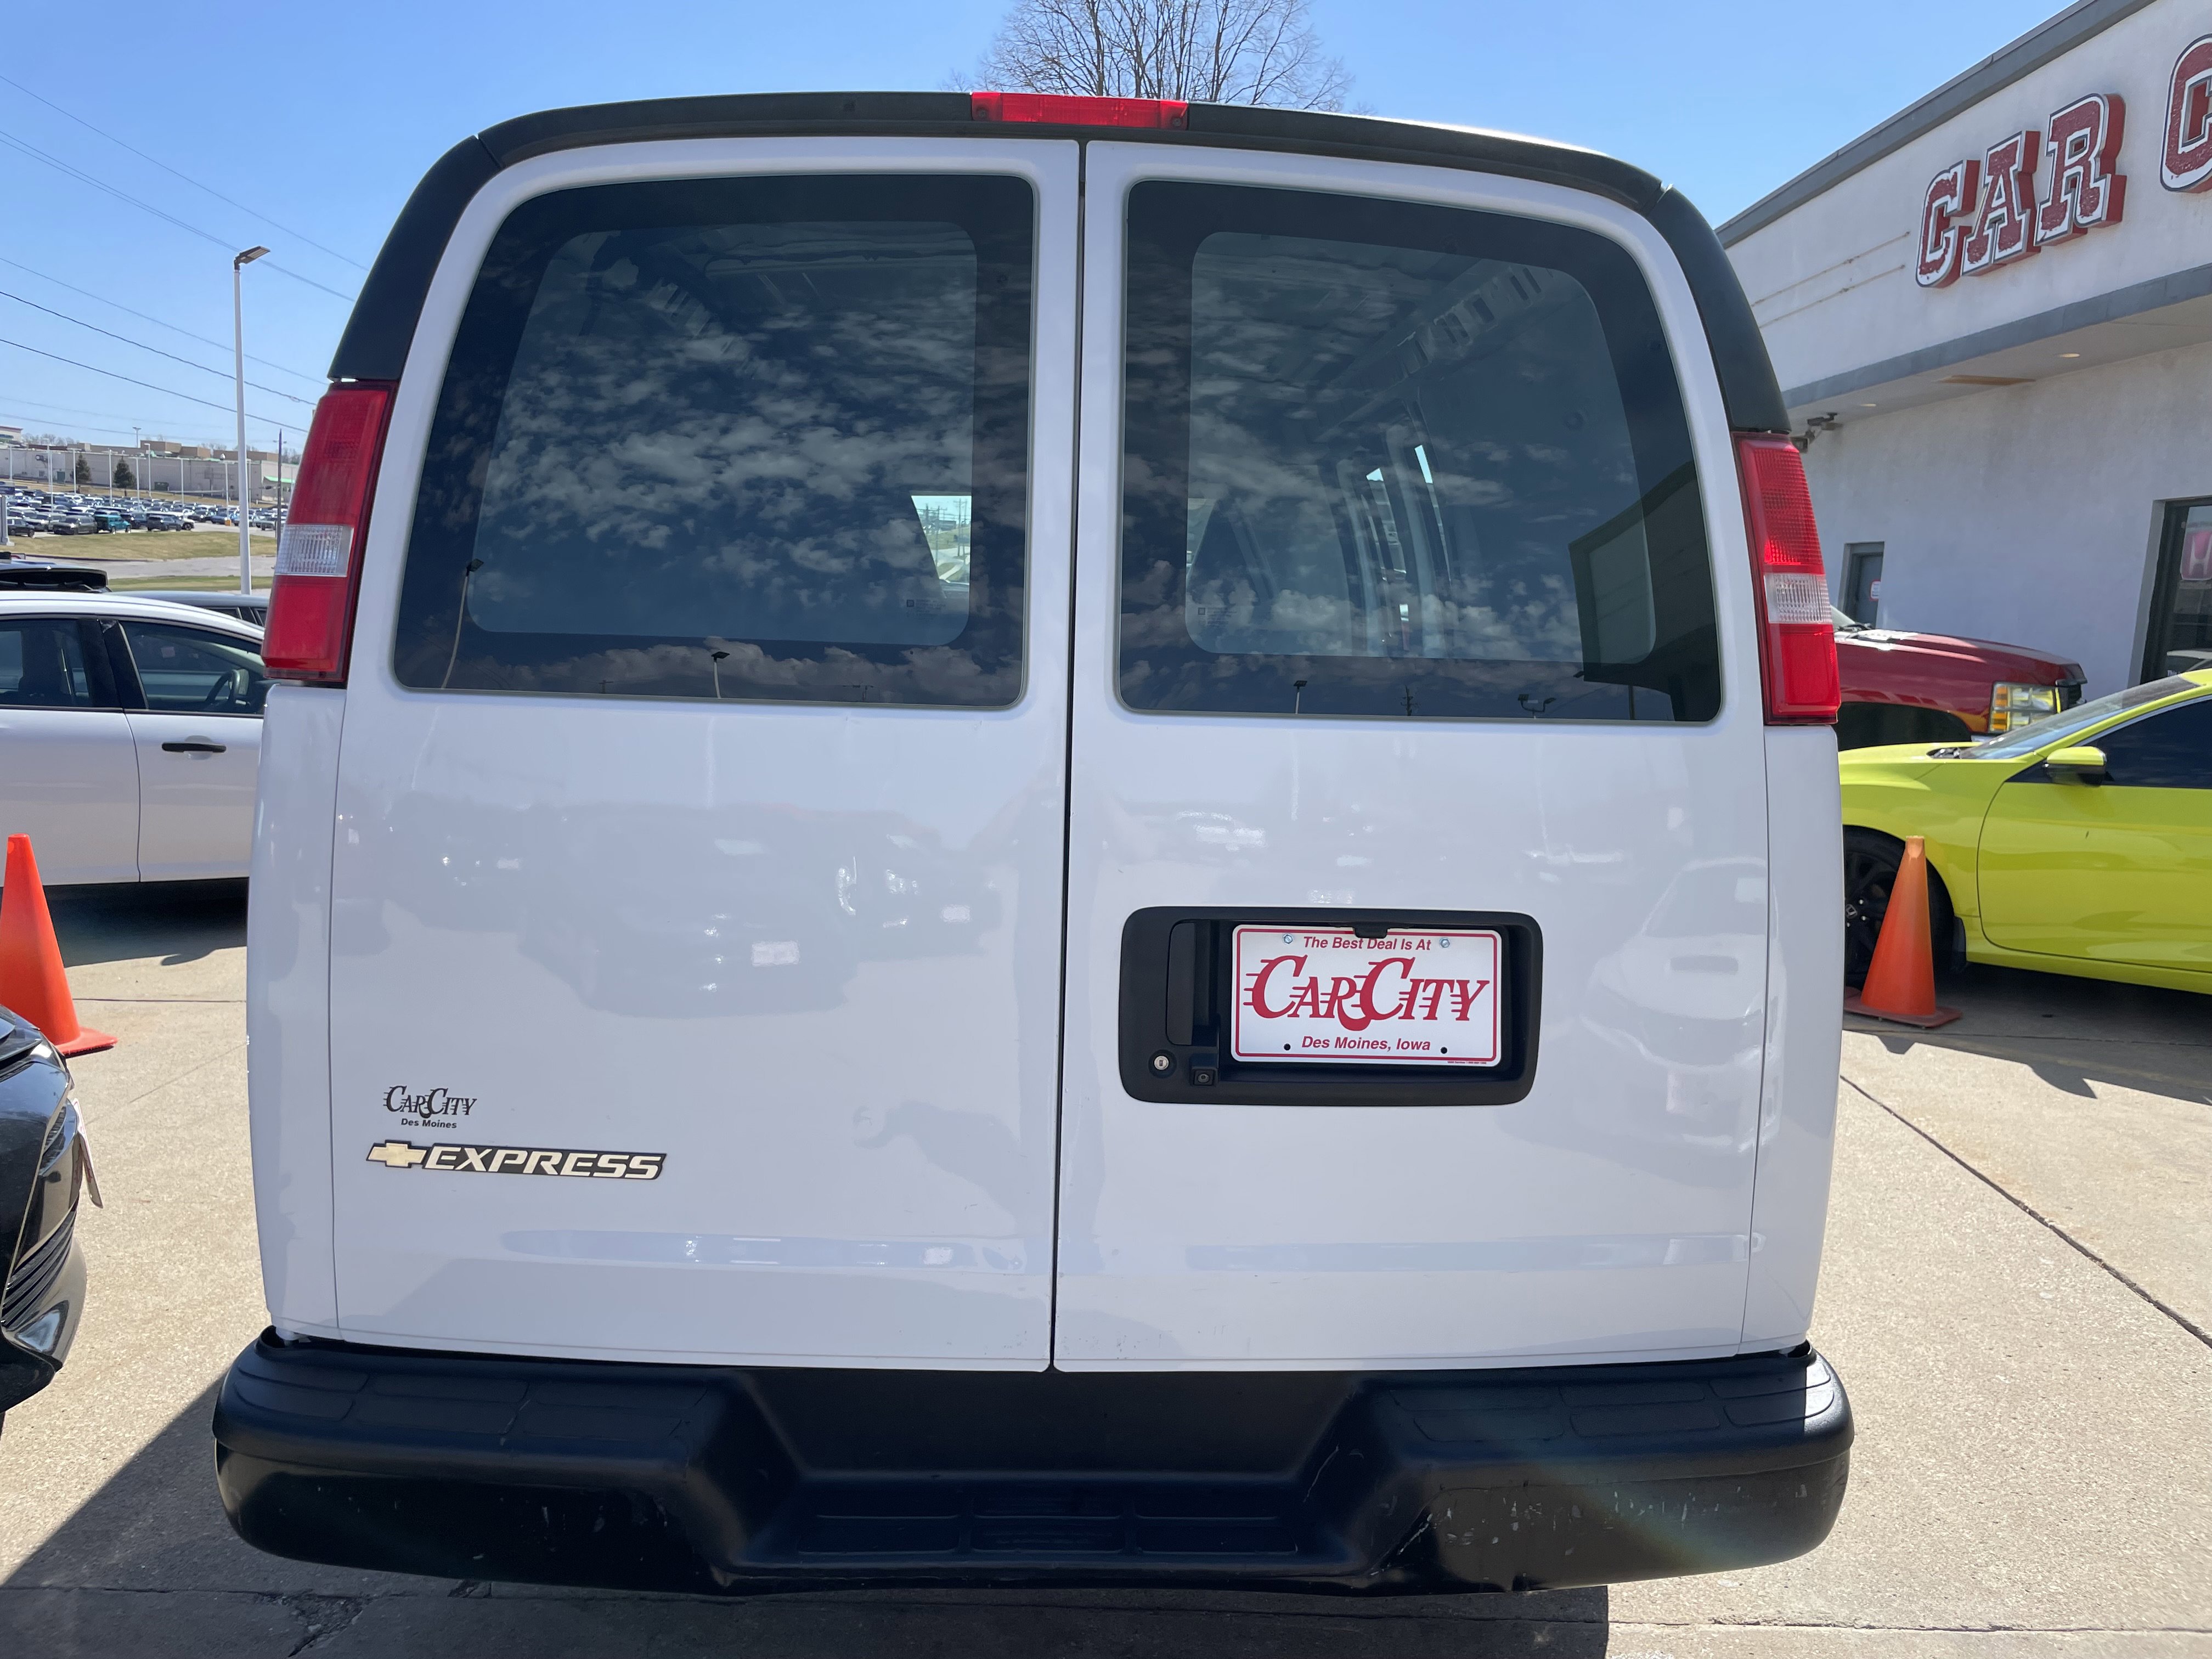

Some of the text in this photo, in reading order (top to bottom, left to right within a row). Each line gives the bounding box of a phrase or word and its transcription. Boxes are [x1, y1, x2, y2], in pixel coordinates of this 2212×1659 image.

[1915, 93, 2126, 288] CAR
[1304, 936, 1432, 951] The Best Deal Is At
[1301, 1036, 1431, 1052] Des Moines, Iowa
[400, 1118, 458, 1128] Des Moines
[424, 1146, 662, 1180] EXPRESS
